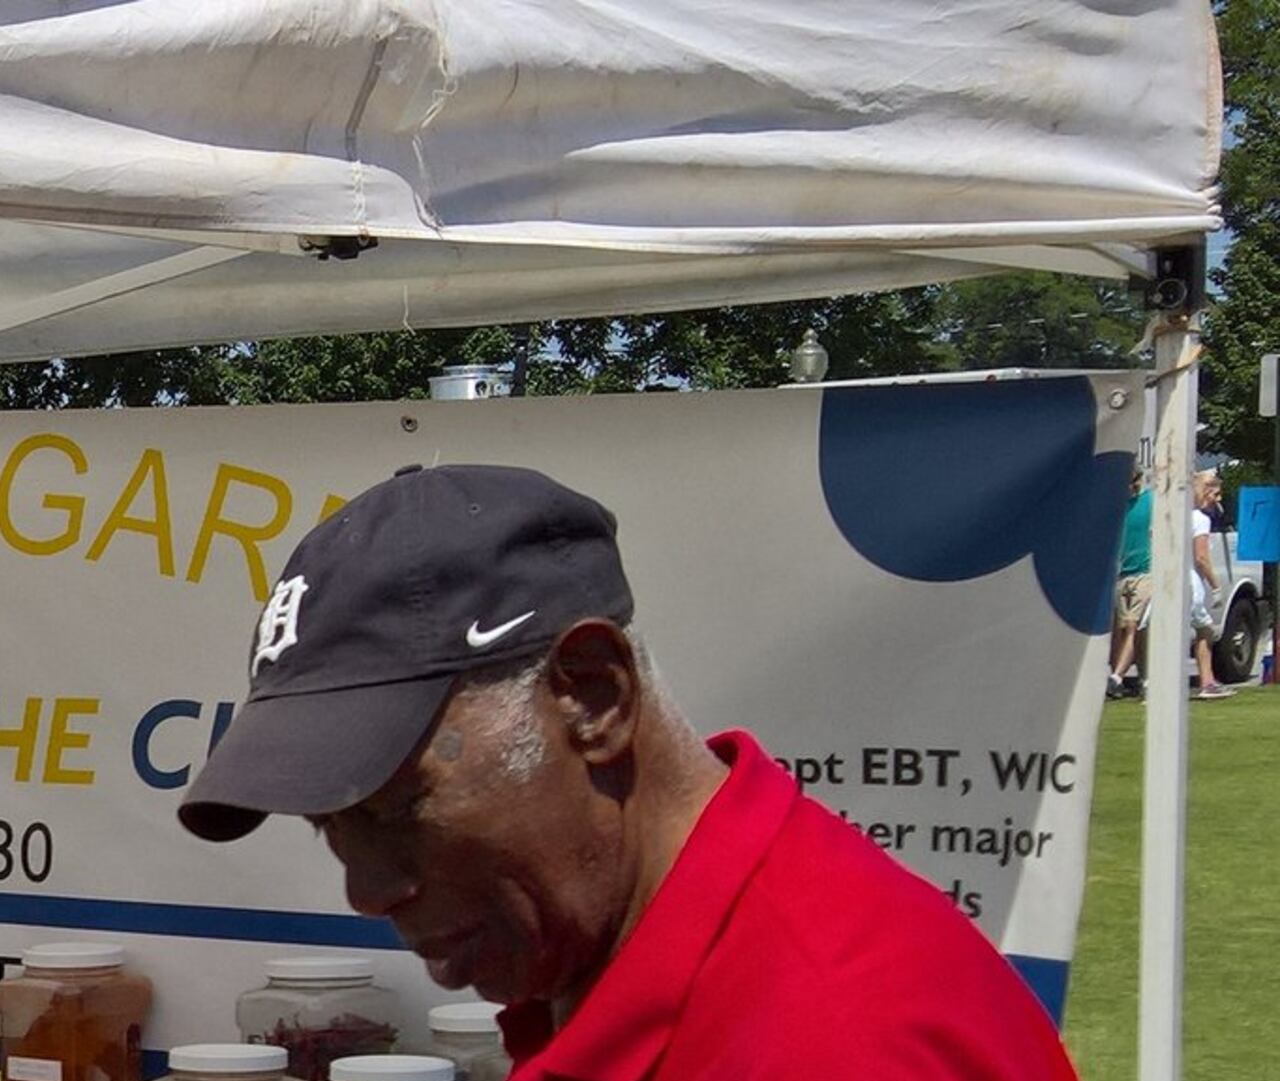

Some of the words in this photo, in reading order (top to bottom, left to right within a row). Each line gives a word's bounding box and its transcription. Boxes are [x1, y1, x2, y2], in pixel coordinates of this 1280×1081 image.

[861, 747, 973, 797] EBT,
[988, 748, 1077, 794] WIC
[930, 816, 1054, 867] major
